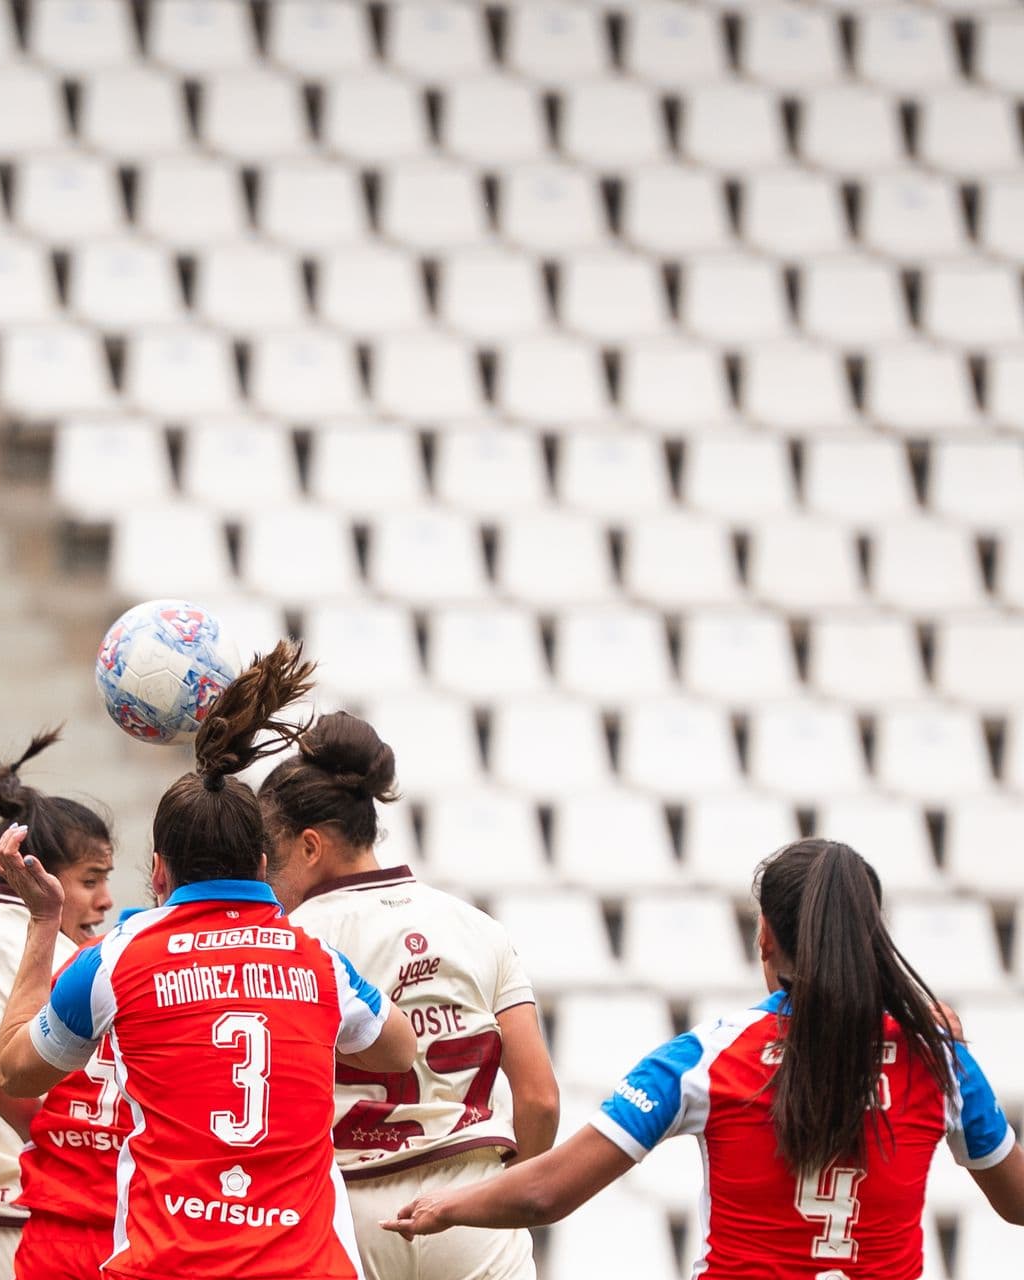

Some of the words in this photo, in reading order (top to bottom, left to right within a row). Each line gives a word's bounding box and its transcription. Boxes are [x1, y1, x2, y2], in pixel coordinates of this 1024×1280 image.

[153, 962, 239, 1008] RAMÍREZ
[243, 964, 319, 1004] MELLADO
[391, 957, 441, 1003] yape
[406, 1004, 466, 1038] OSTE
[210, 1011, 272, 1148] 3
[164, 1194, 300, 1227] verisure
[795, 1160, 867, 1263] 4
